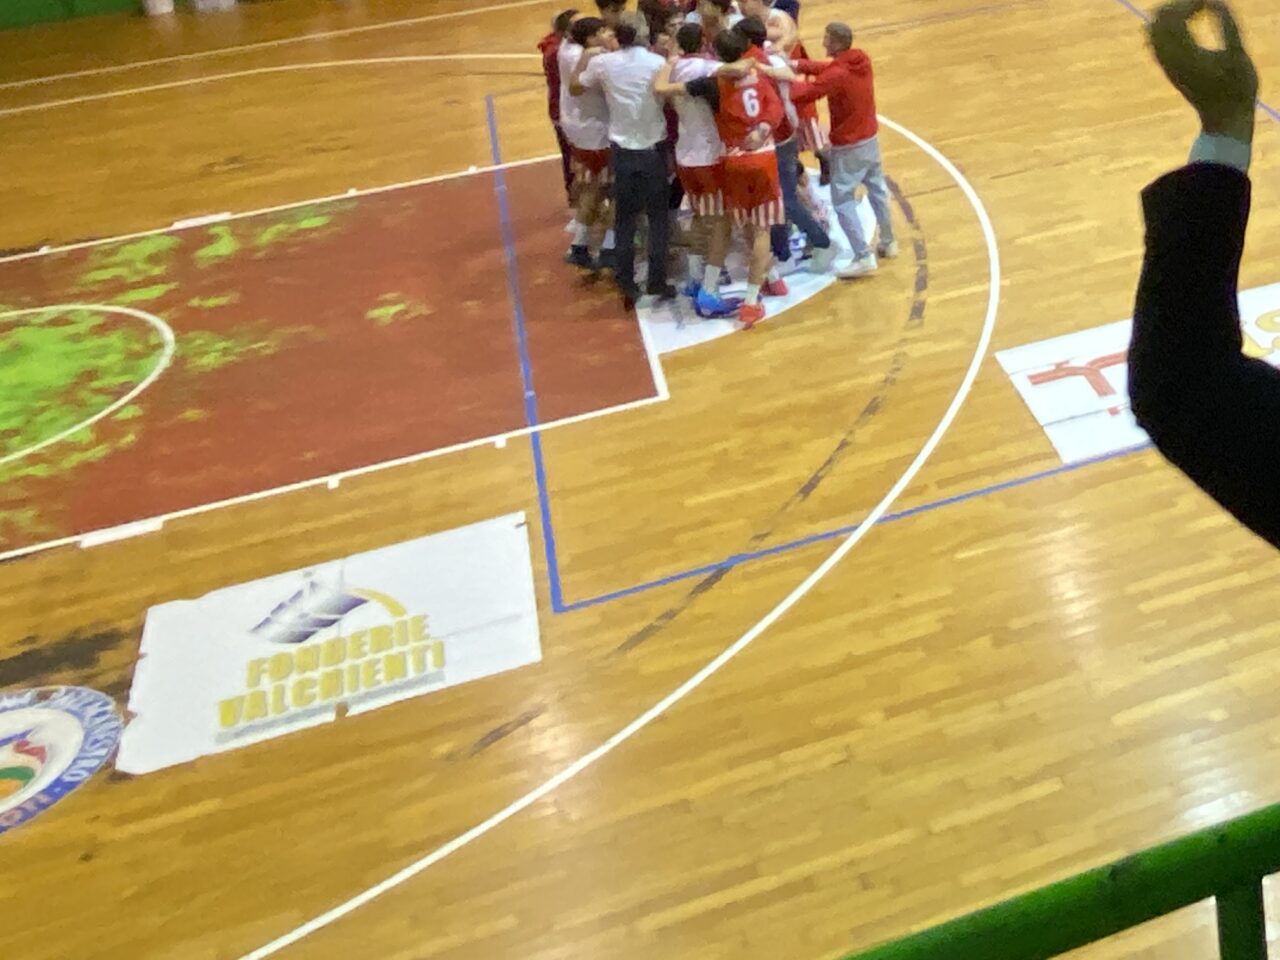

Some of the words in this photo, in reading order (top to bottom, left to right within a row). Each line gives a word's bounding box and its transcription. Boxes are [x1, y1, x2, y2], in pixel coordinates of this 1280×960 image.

[742, 88, 760, 117] 6
[219, 640, 445, 728] VALCHIENTI
[246, 614, 429, 689] FONDERIE
